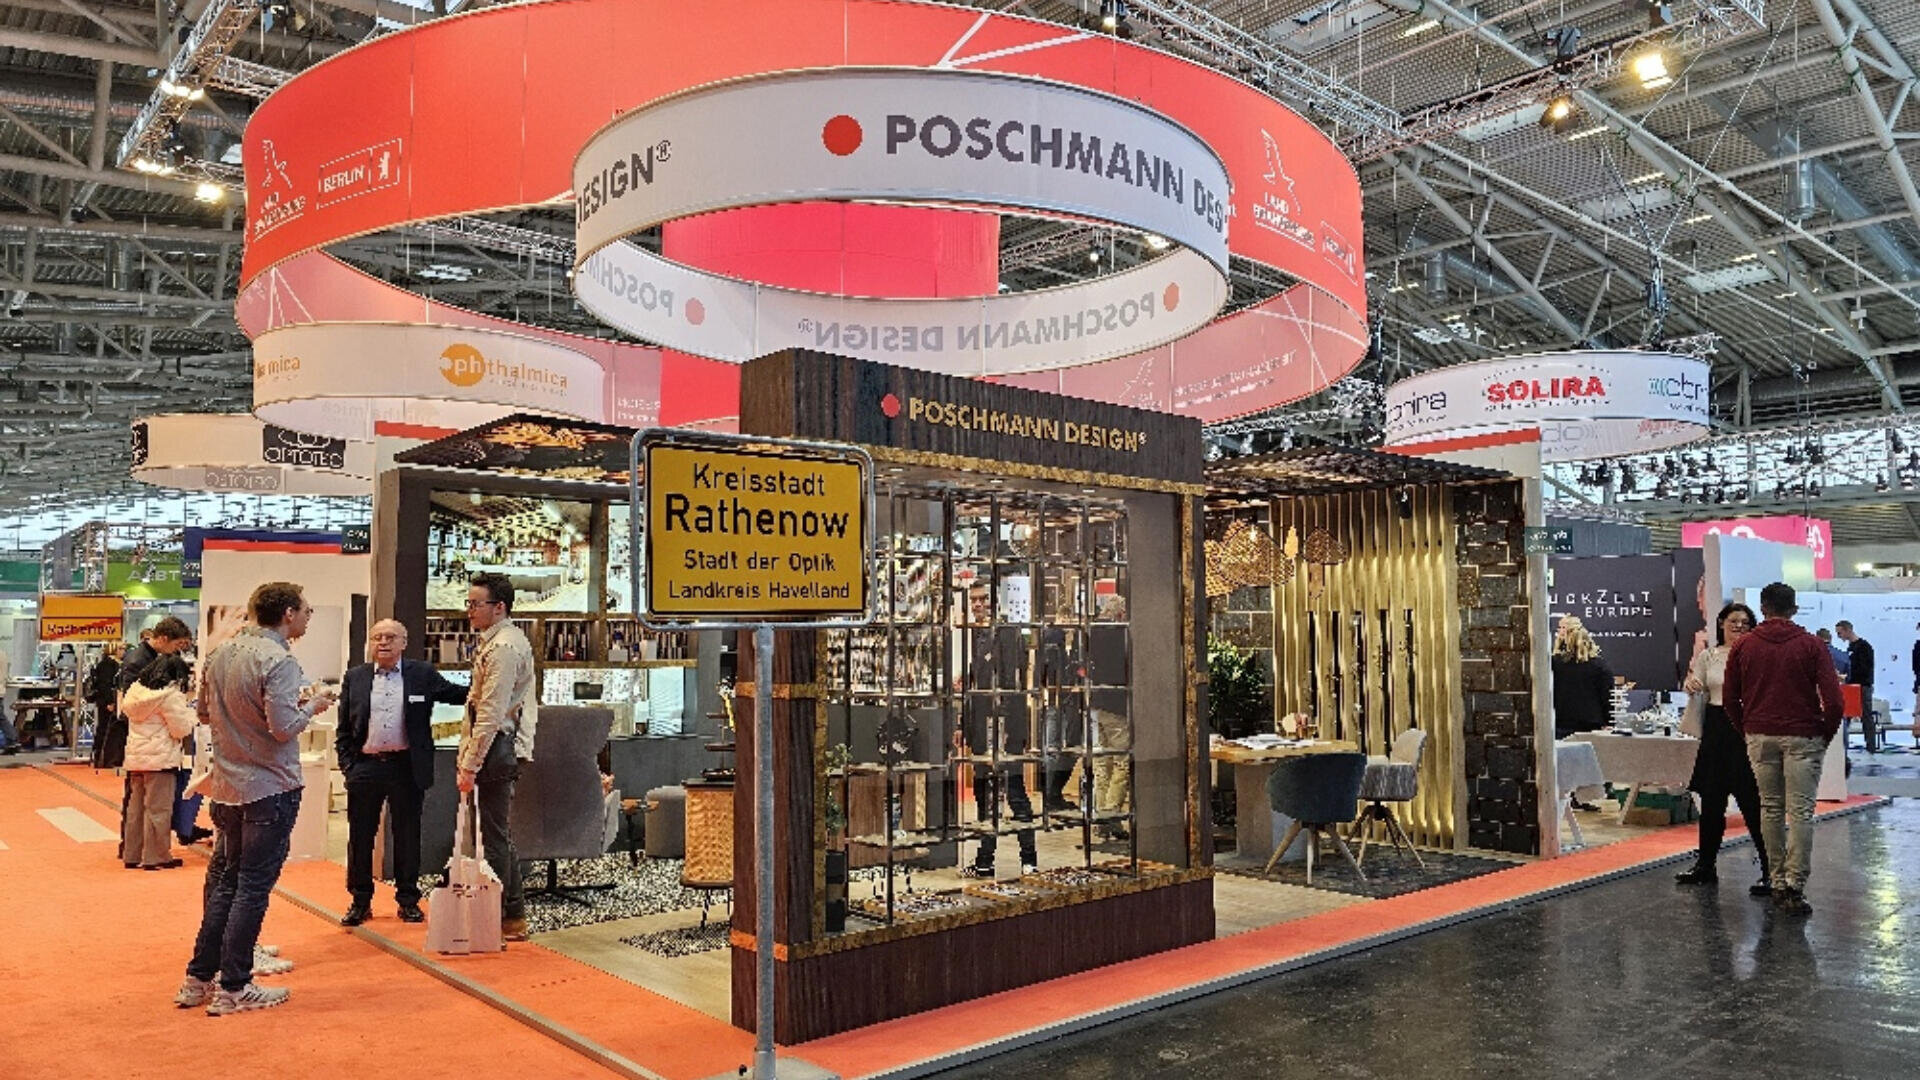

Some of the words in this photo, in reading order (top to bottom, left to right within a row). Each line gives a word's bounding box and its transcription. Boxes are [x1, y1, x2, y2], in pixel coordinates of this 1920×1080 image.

[323, 165, 366, 192] BERLIN
[886, 115, 1184, 204] POSCHMANN
[1193, 179, 1227, 238] DES
[1487, 376, 1606, 402] SOLIRA
[909, 397, 1059, 441] POSCHMANN
[264, 447, 343, 468] OPTOTEC
[694, 463, 825, 496] Kreisstadt
[665, 493, 849, 539] Rathenow
[684, 549, 738, 570] Stadt
[747, 551, 780, 570] der
[788, 552, 836, 575] Optik
[669, 580, 760, 599] Landkreis
[769, 581, 850, 599] Havelland
[47, 623, 117, 636] Rathenow
